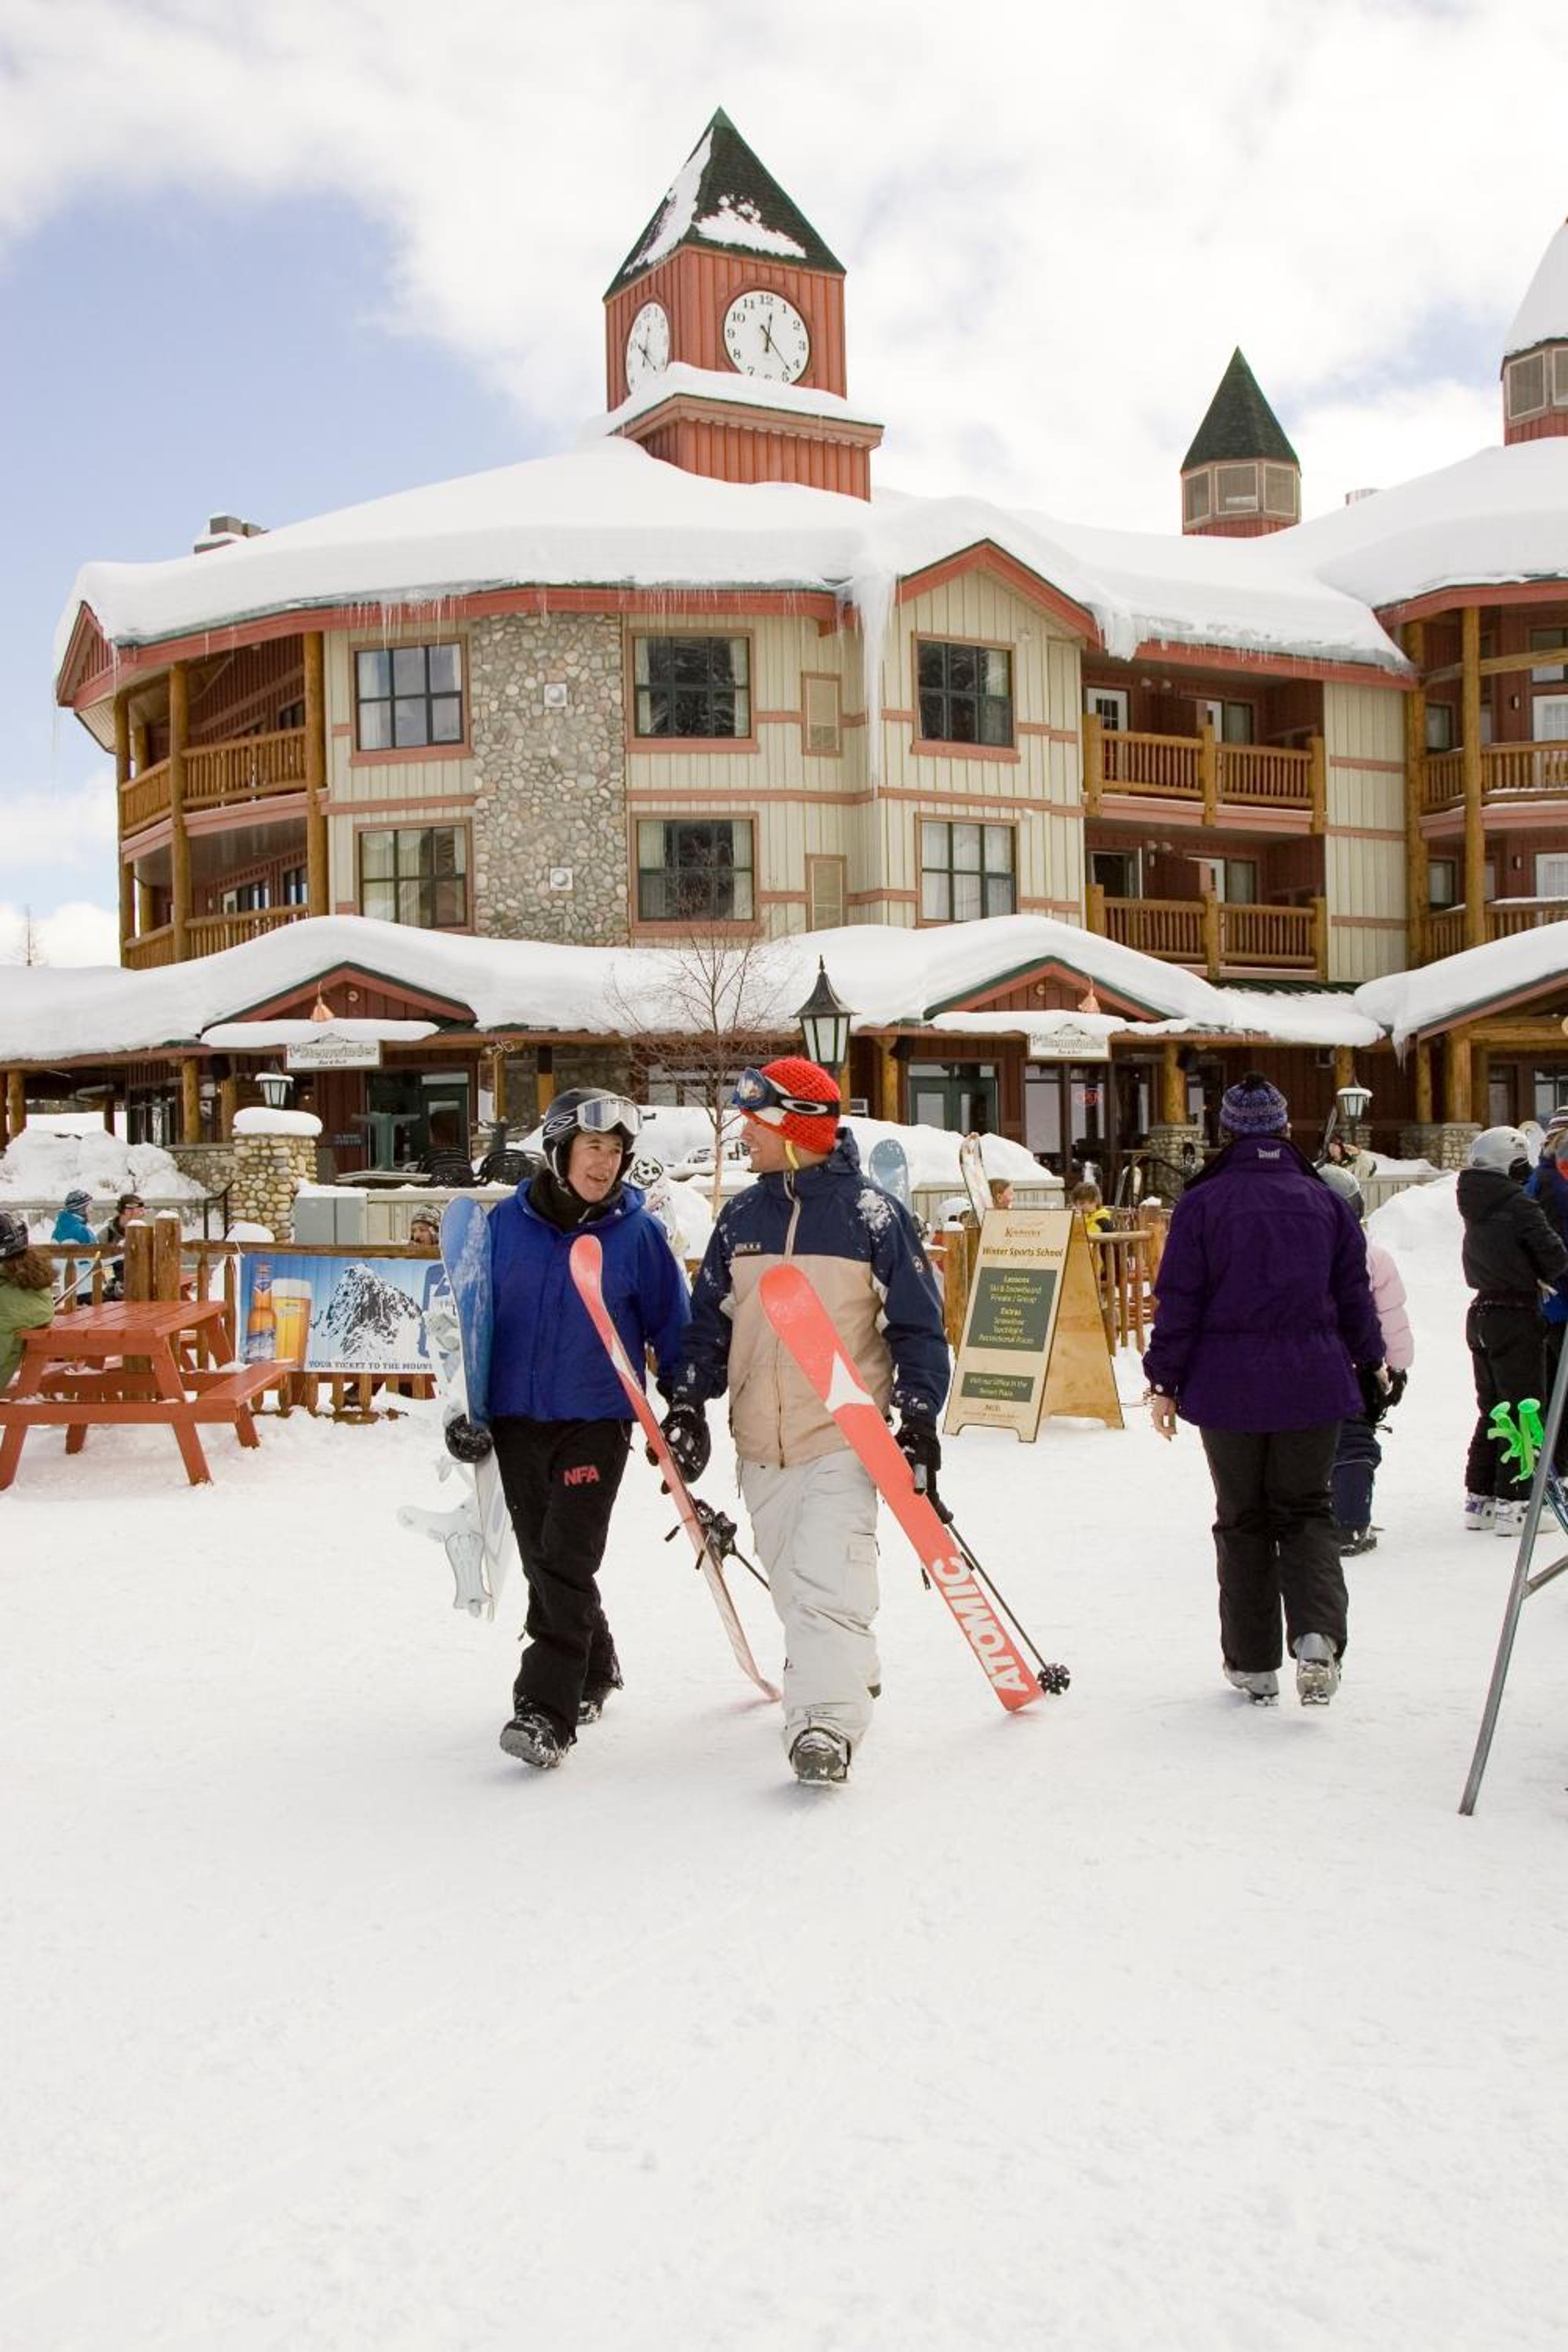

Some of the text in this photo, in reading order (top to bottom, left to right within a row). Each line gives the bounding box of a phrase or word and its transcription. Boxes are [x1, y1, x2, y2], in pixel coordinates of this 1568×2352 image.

[744, 298, 755, 310] 11
[760, 294, 774, 306] 12
[732, 312, 746, 323] 10
[793, 320, 800, 331] 2
[727, 328, 735, 339] 9
[798, 340, 806, 351] 3
[733, 348, 741, 359] 8
[793, 358, 800, 368] 4
[982, 1246, 1064, 1258] Winter Sports School
[309, 1360, 332, 1369] YOUR
[932, 1555, 1029, 1693] ATOMIC
